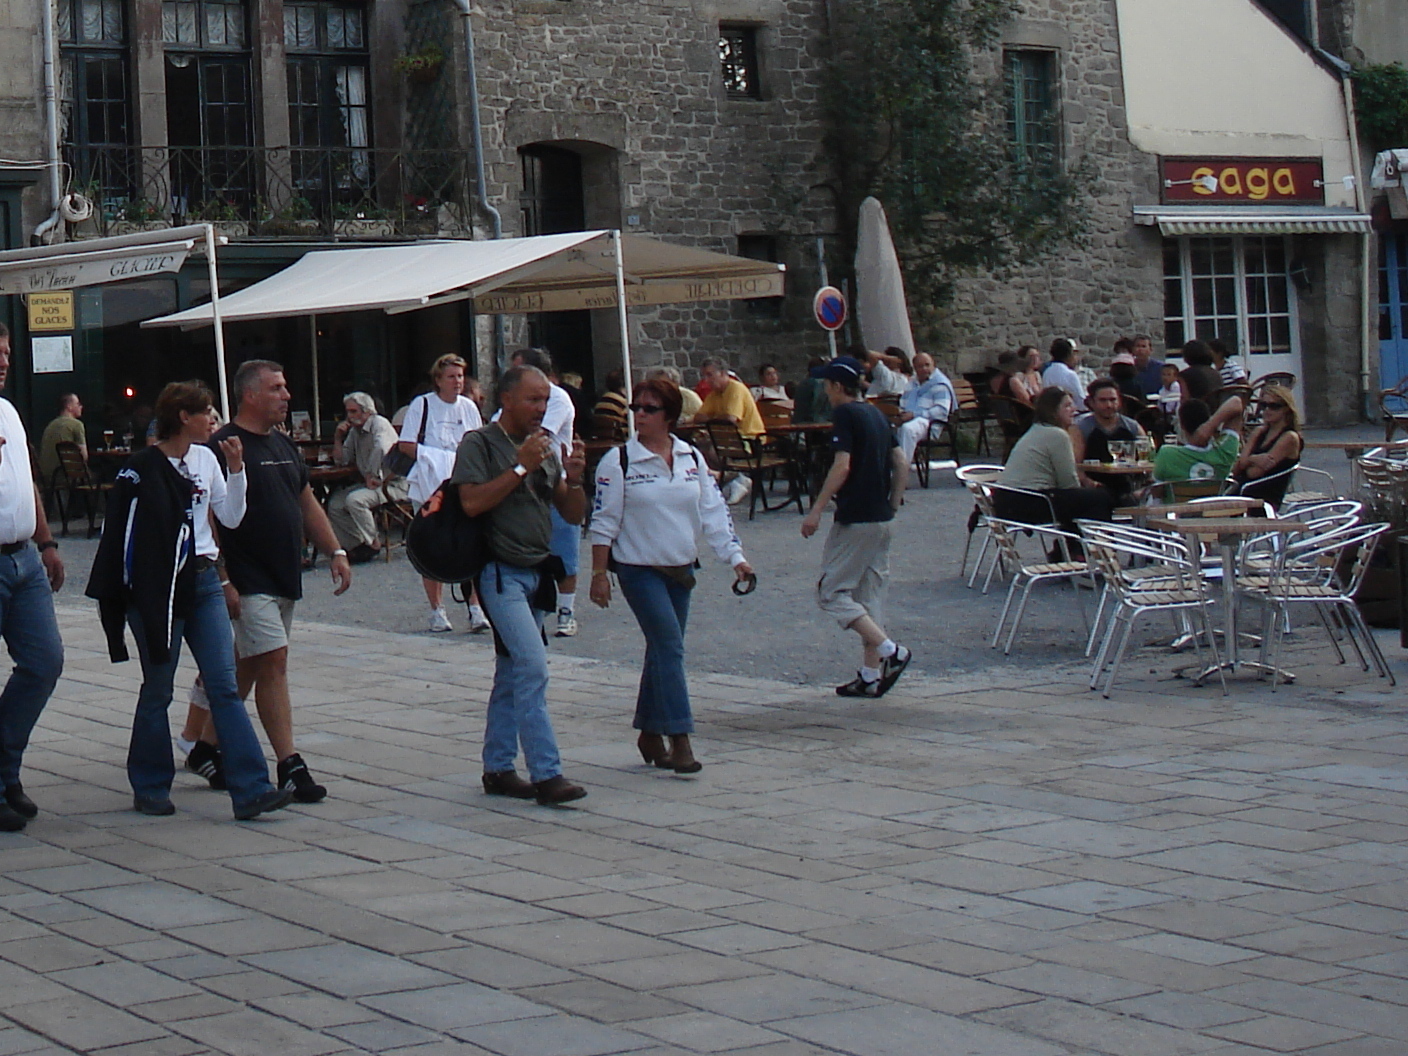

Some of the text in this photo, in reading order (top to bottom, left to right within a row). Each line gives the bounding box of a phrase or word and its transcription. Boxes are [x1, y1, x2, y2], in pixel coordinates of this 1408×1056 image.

[109, 255, 176, 278] GLACIER
[31, 297, 70, 305] DEMANDEZ
[42, 306, 60, 314] NOS
[35, 316, 68, 324] GLACES
